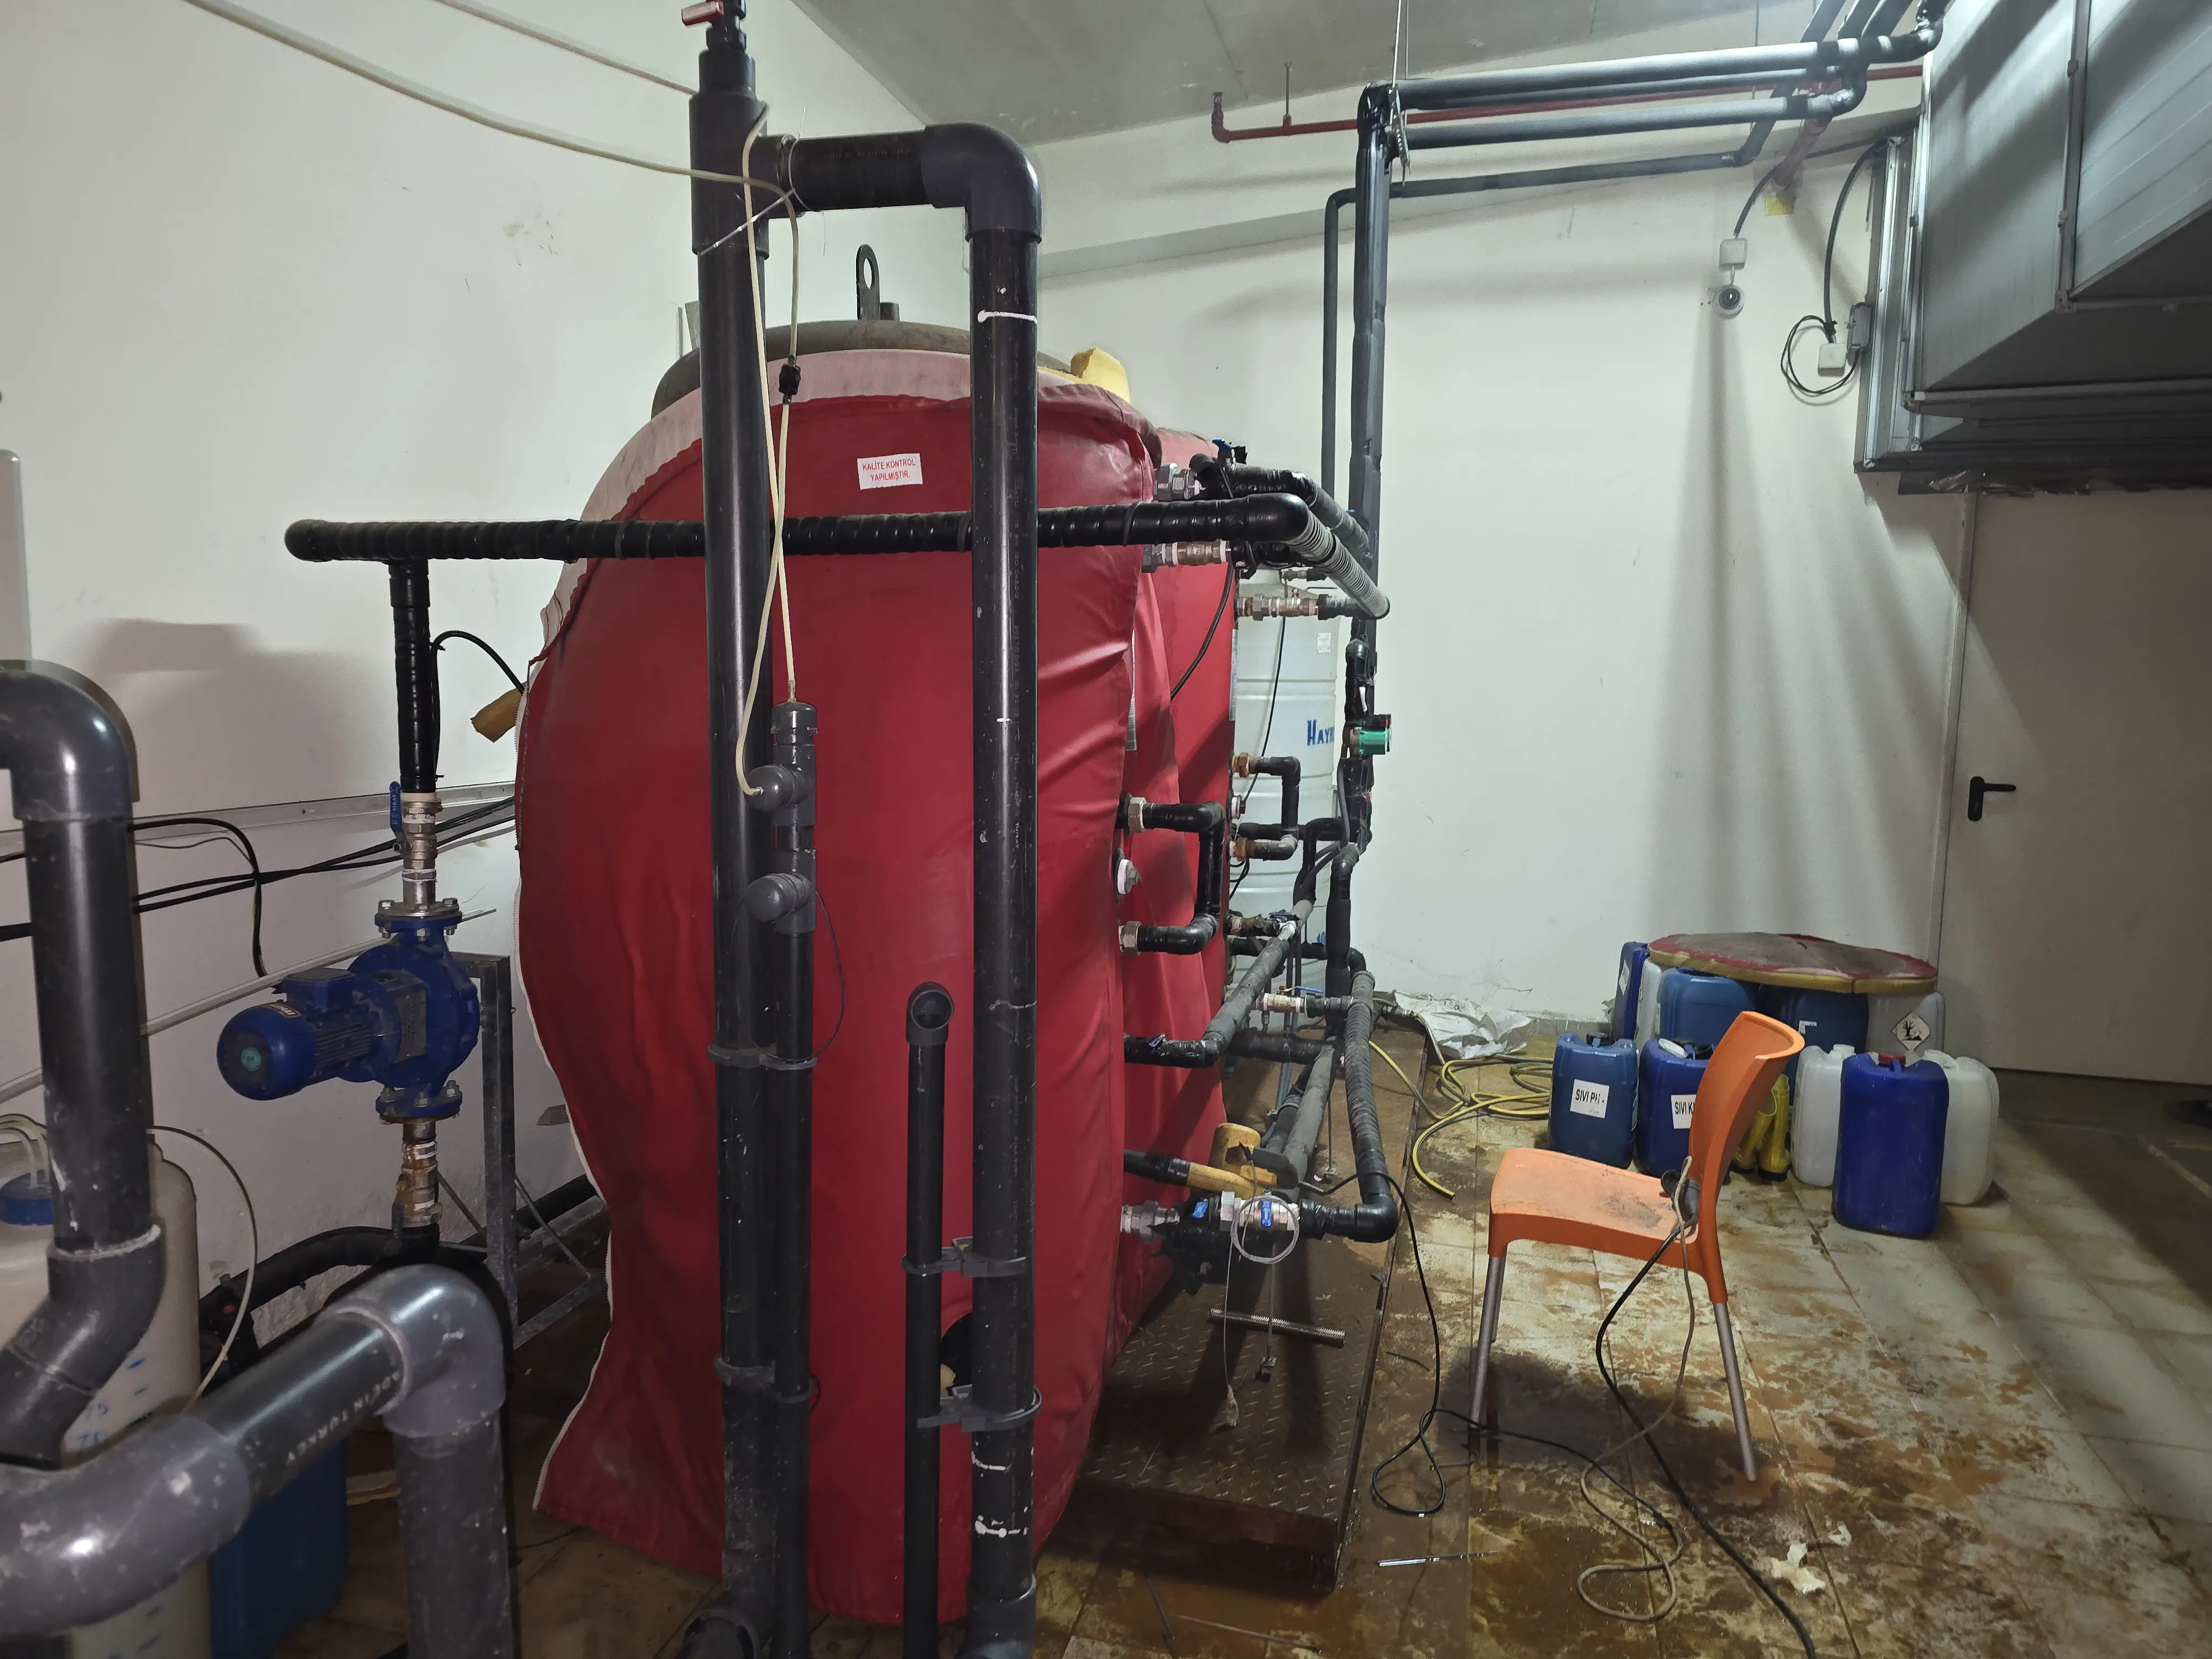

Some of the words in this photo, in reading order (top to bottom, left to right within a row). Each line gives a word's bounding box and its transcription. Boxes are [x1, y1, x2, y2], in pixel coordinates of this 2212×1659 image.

[863, 461, 885, 471] KALİTE
[886, 458, 916, 469] KONTROL
[1575, 1089, 1589, 1102] SIVI
[1675, 1102, 1686, 1115] SIVI
